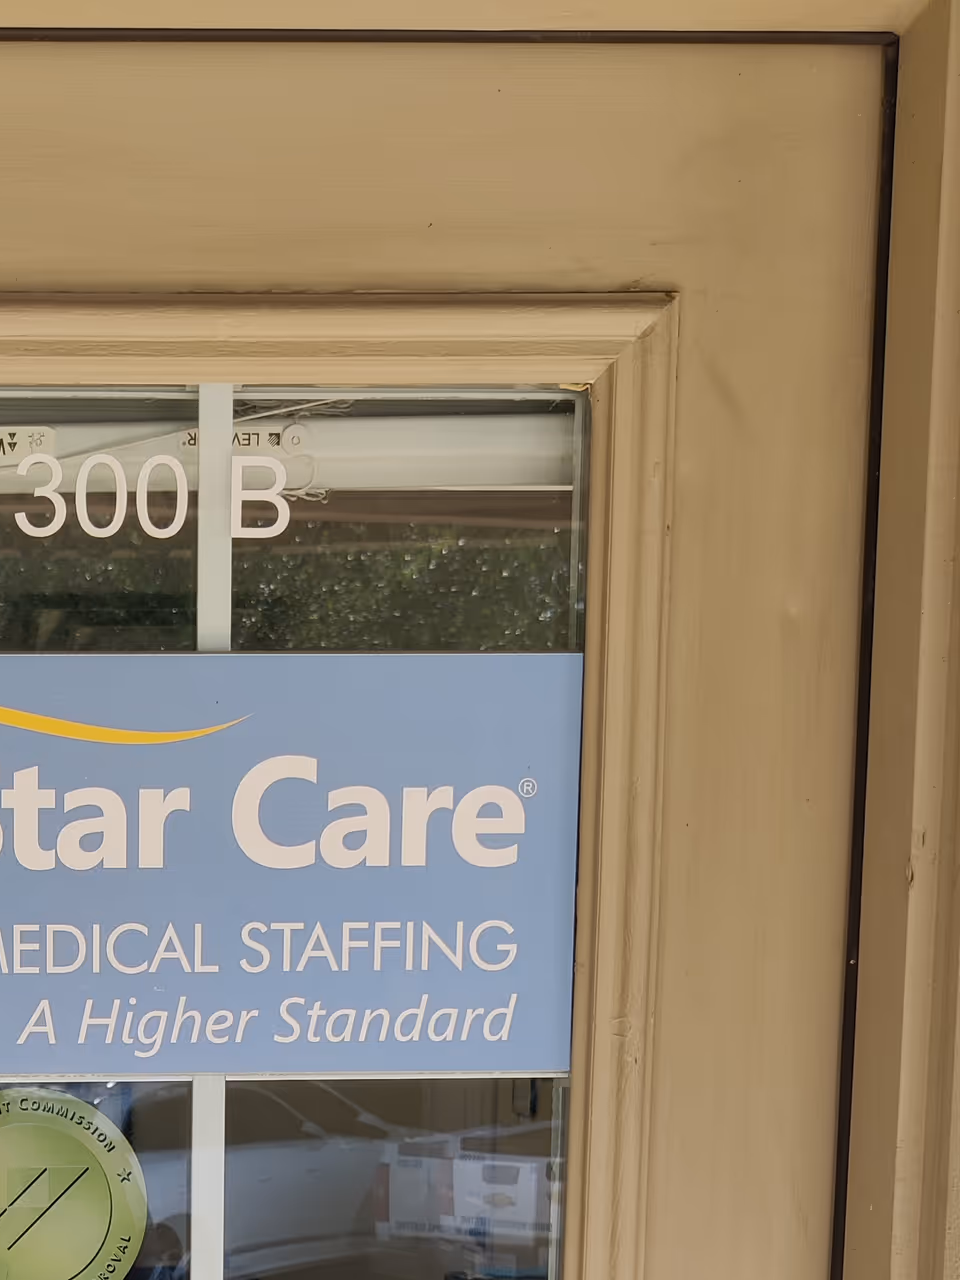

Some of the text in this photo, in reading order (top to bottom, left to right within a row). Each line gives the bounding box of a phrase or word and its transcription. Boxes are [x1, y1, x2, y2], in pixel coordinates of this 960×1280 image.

[14, 453, 189, 540] 300
[230, 455, 292, 539] B
[239, 919, 519, 974] STAFFING
[16, 993, 518, 1059] A Higher Standard
[18, 1097, 117, 1154] COMMISSION
